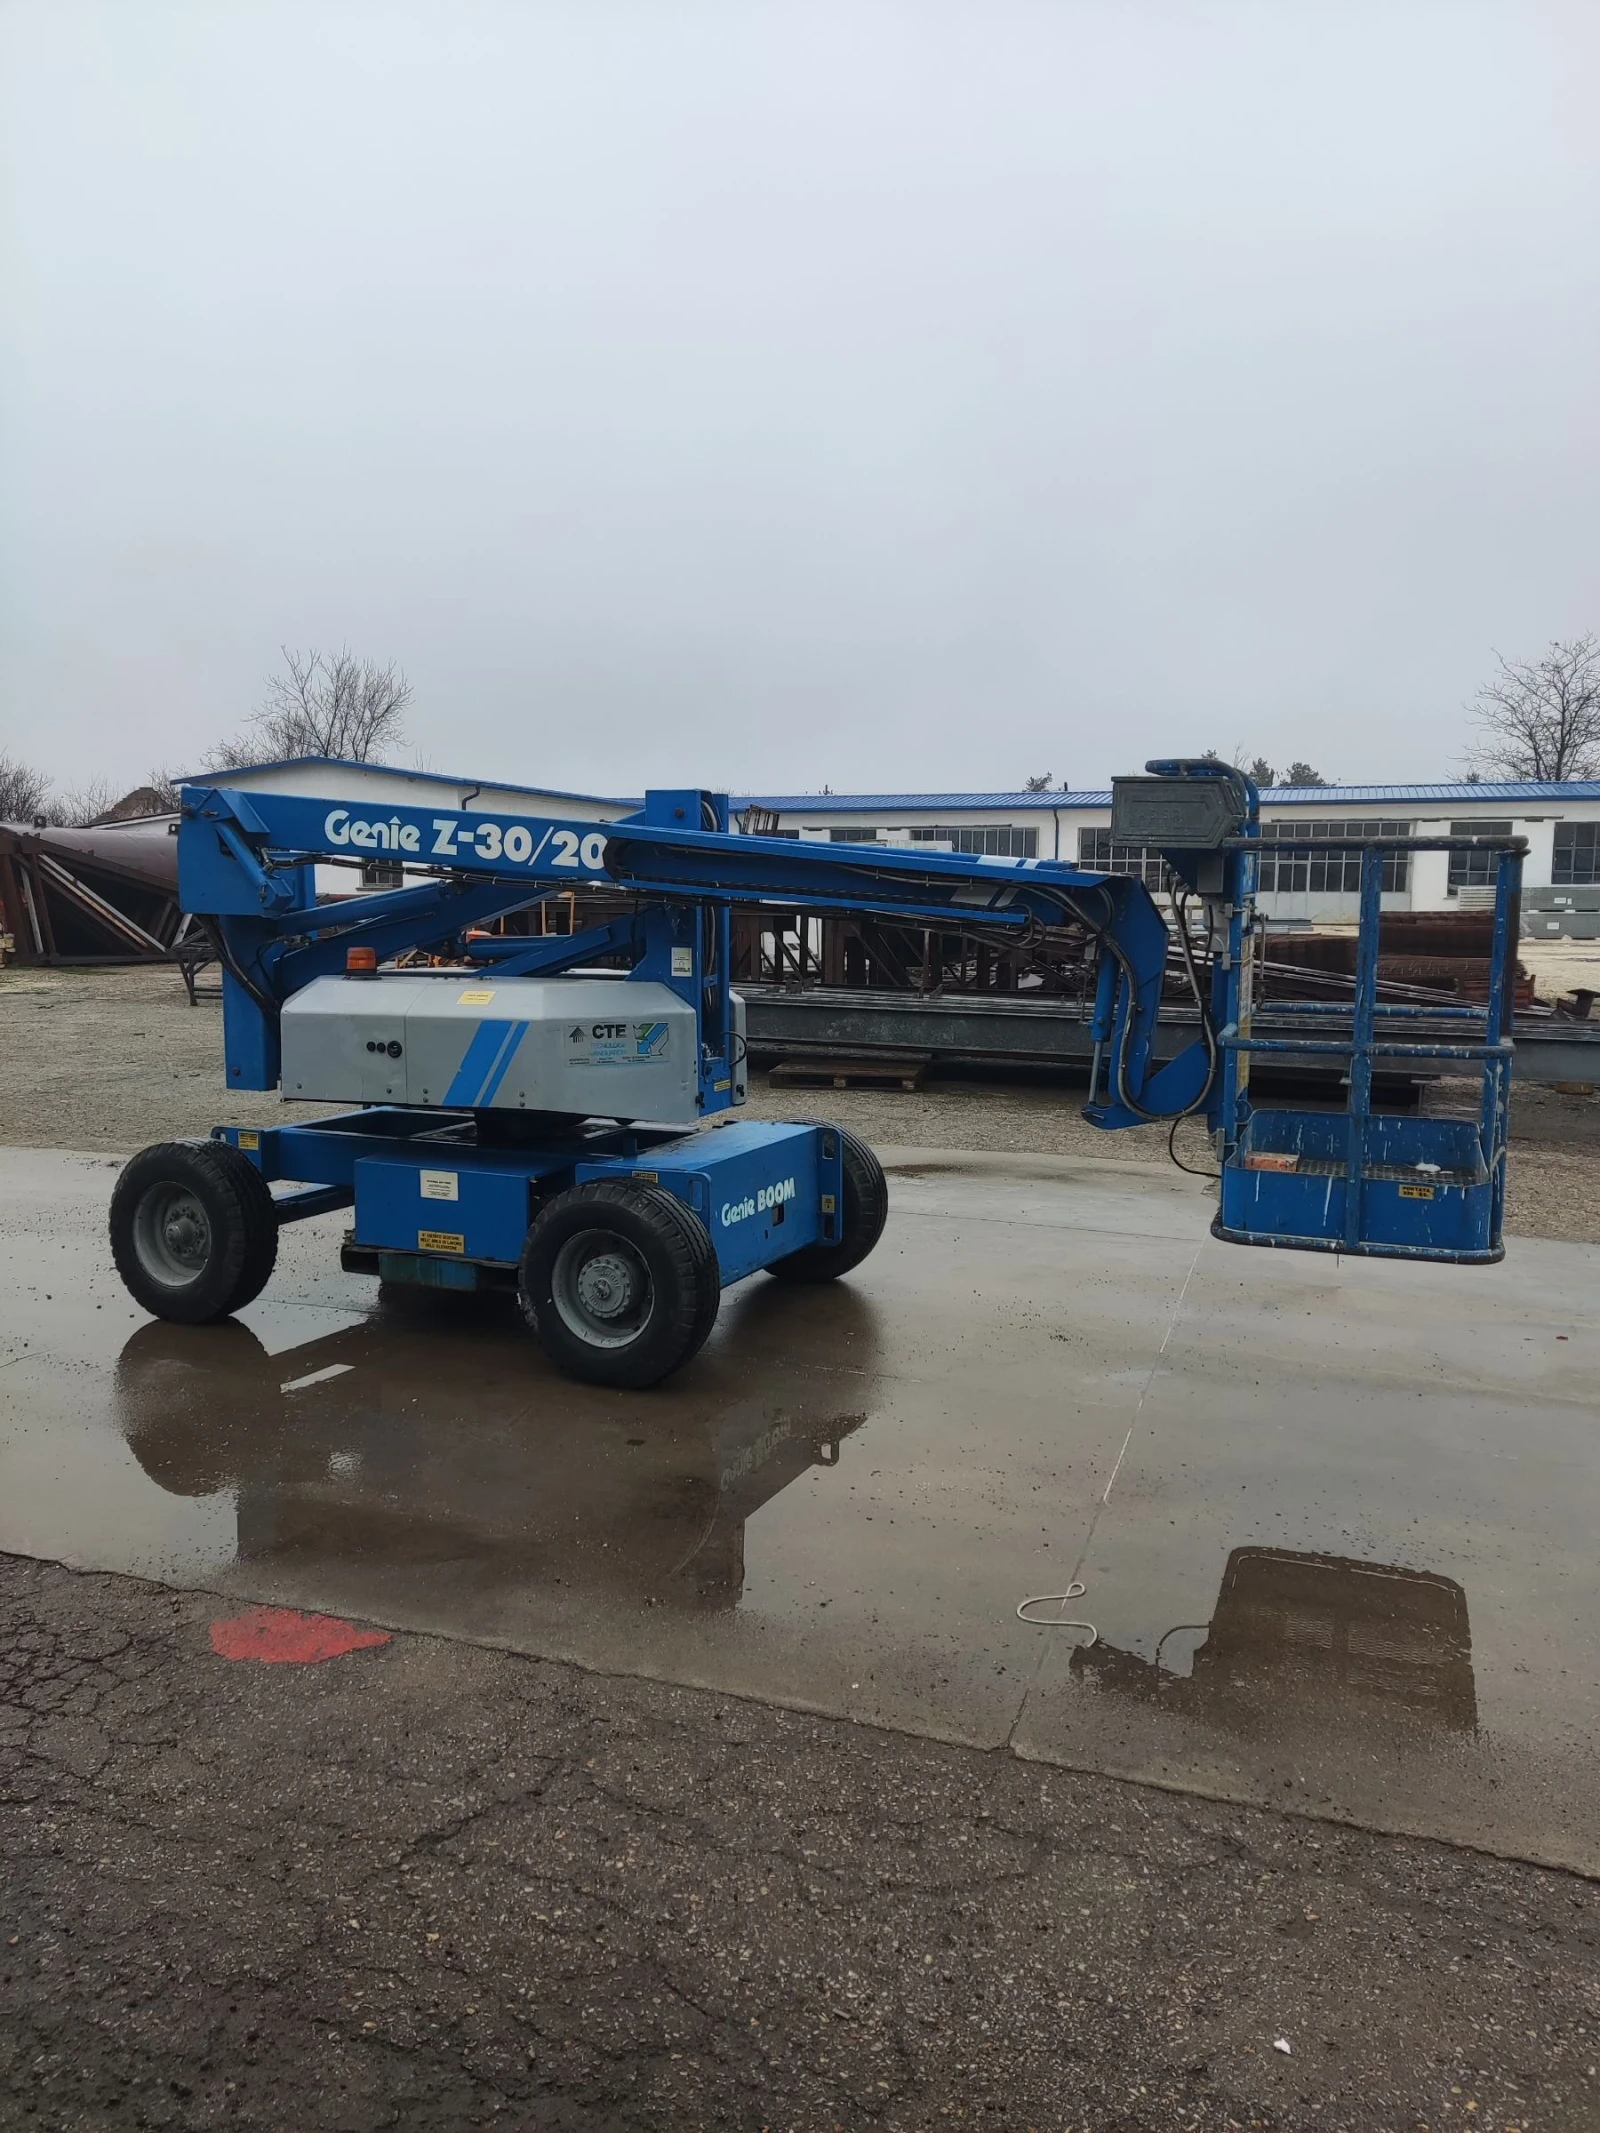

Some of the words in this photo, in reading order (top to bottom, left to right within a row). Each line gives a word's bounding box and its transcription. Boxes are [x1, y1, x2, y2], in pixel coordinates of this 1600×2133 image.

[324, 809, 421, 852] Genie
[431, 818, 609, 870] Z-30/20
[592, 1024, 627, 1040] CTE
[721, 1196, 755, 1227] Genie
[757, 1177, 796, 1212] BOOM
